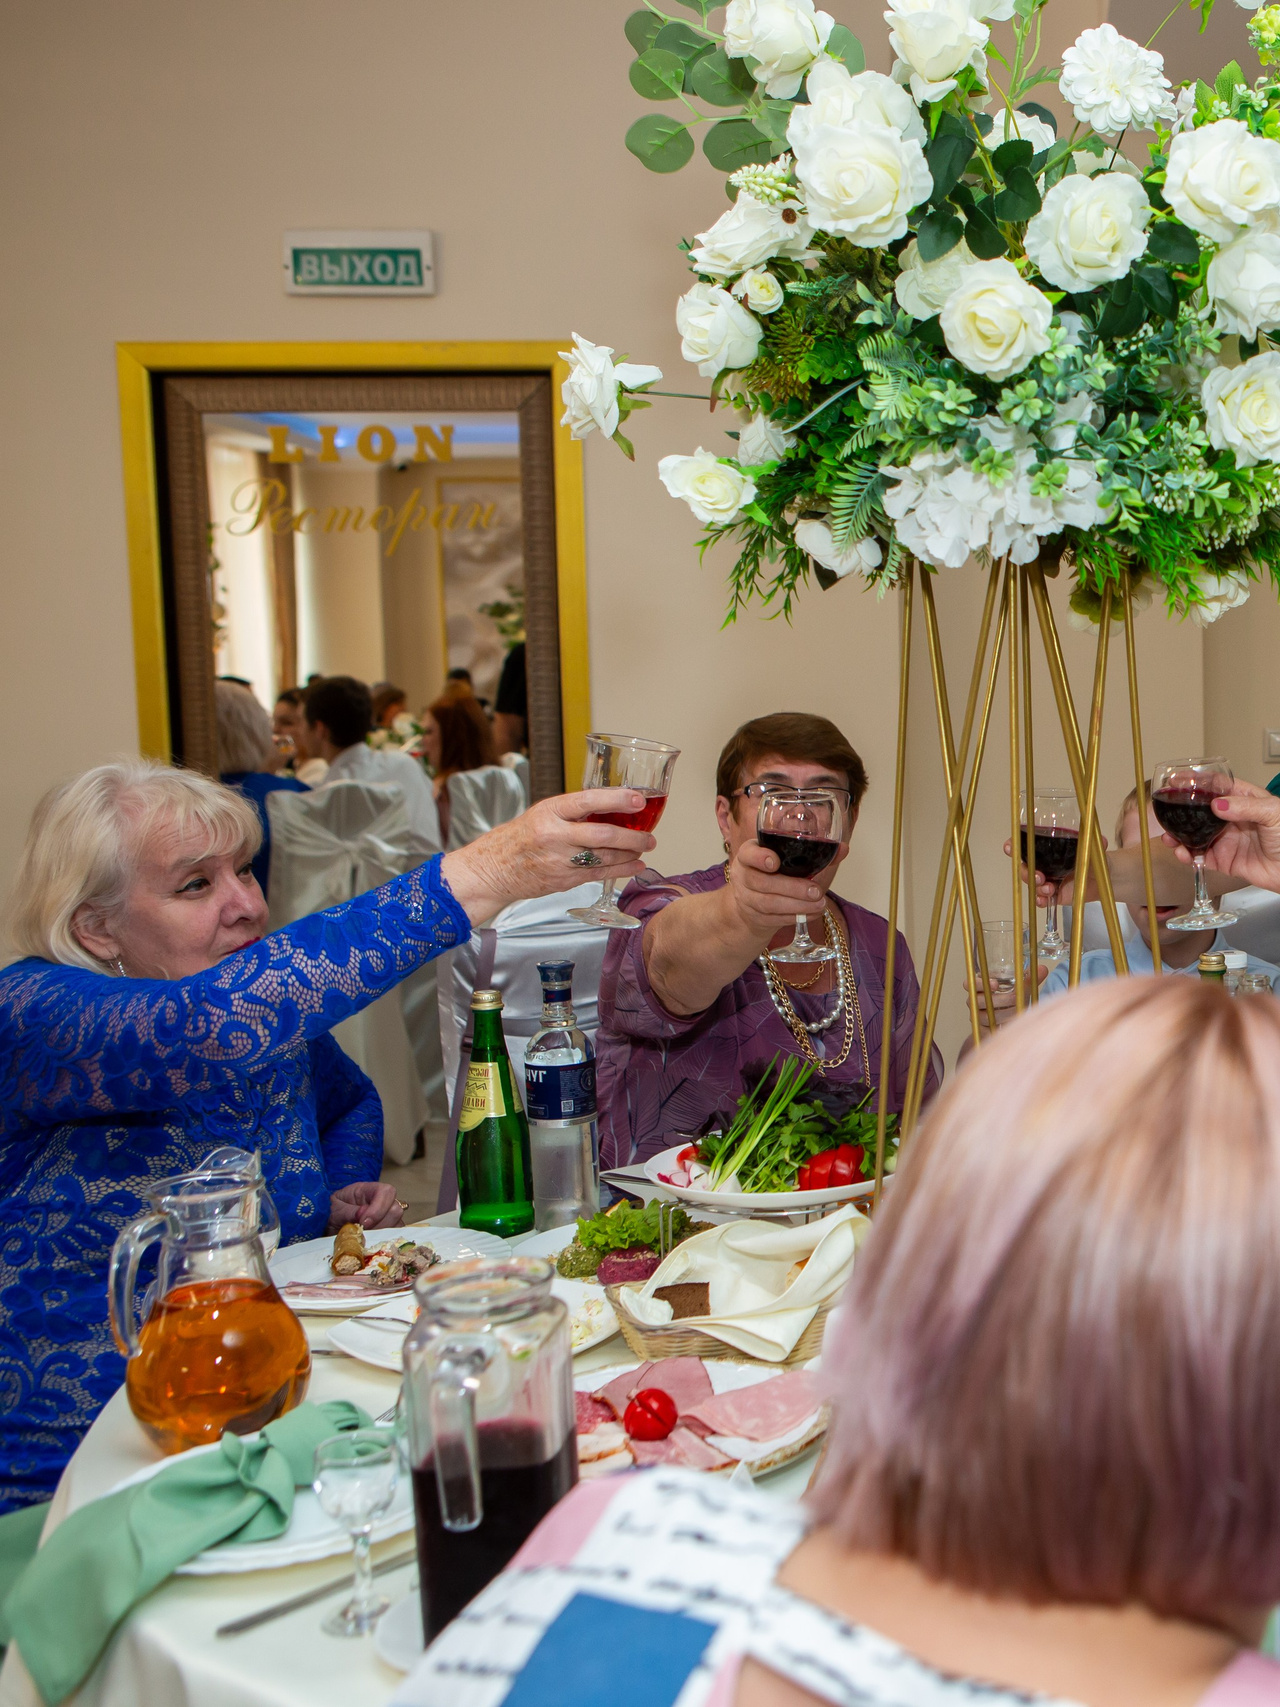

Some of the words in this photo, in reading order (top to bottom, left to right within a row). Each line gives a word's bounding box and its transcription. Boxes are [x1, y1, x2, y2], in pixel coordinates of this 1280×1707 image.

[300, 253, 420, 284] ВЫХОД
[266, 424, 454, 463] LION
[225, 477, 498, 557] Ресторан
